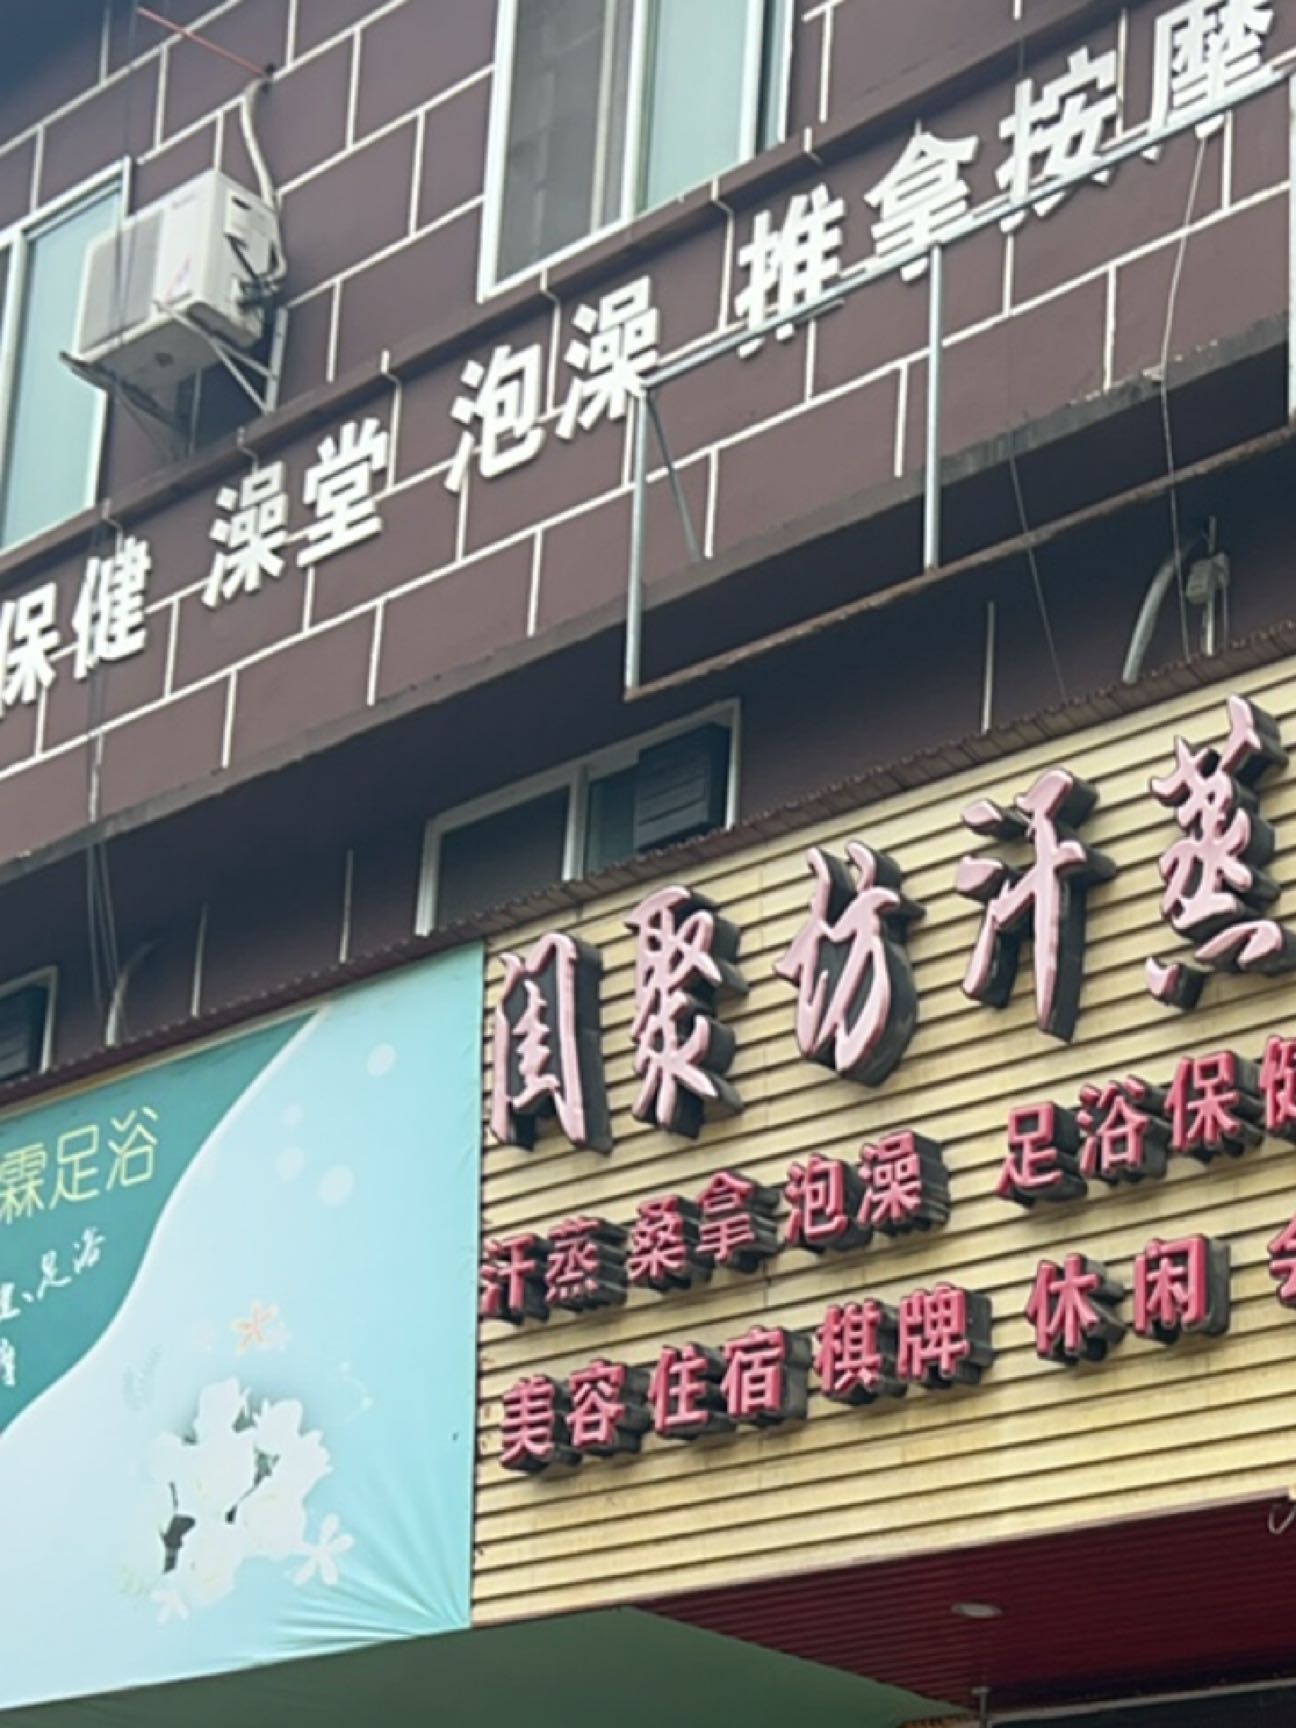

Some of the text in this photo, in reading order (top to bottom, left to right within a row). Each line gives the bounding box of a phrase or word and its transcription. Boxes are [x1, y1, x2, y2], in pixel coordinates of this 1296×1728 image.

[0, 0, 1275, 715] 保健 澡堂 泡澡 推拿按摩
[478, 1129, 925, 1318] 汗蒸桑拿泡澡
[499, 1282, 974, 1466] 美容住宿棋牌
[1024, 1233, 1208, 1358] 休闲
